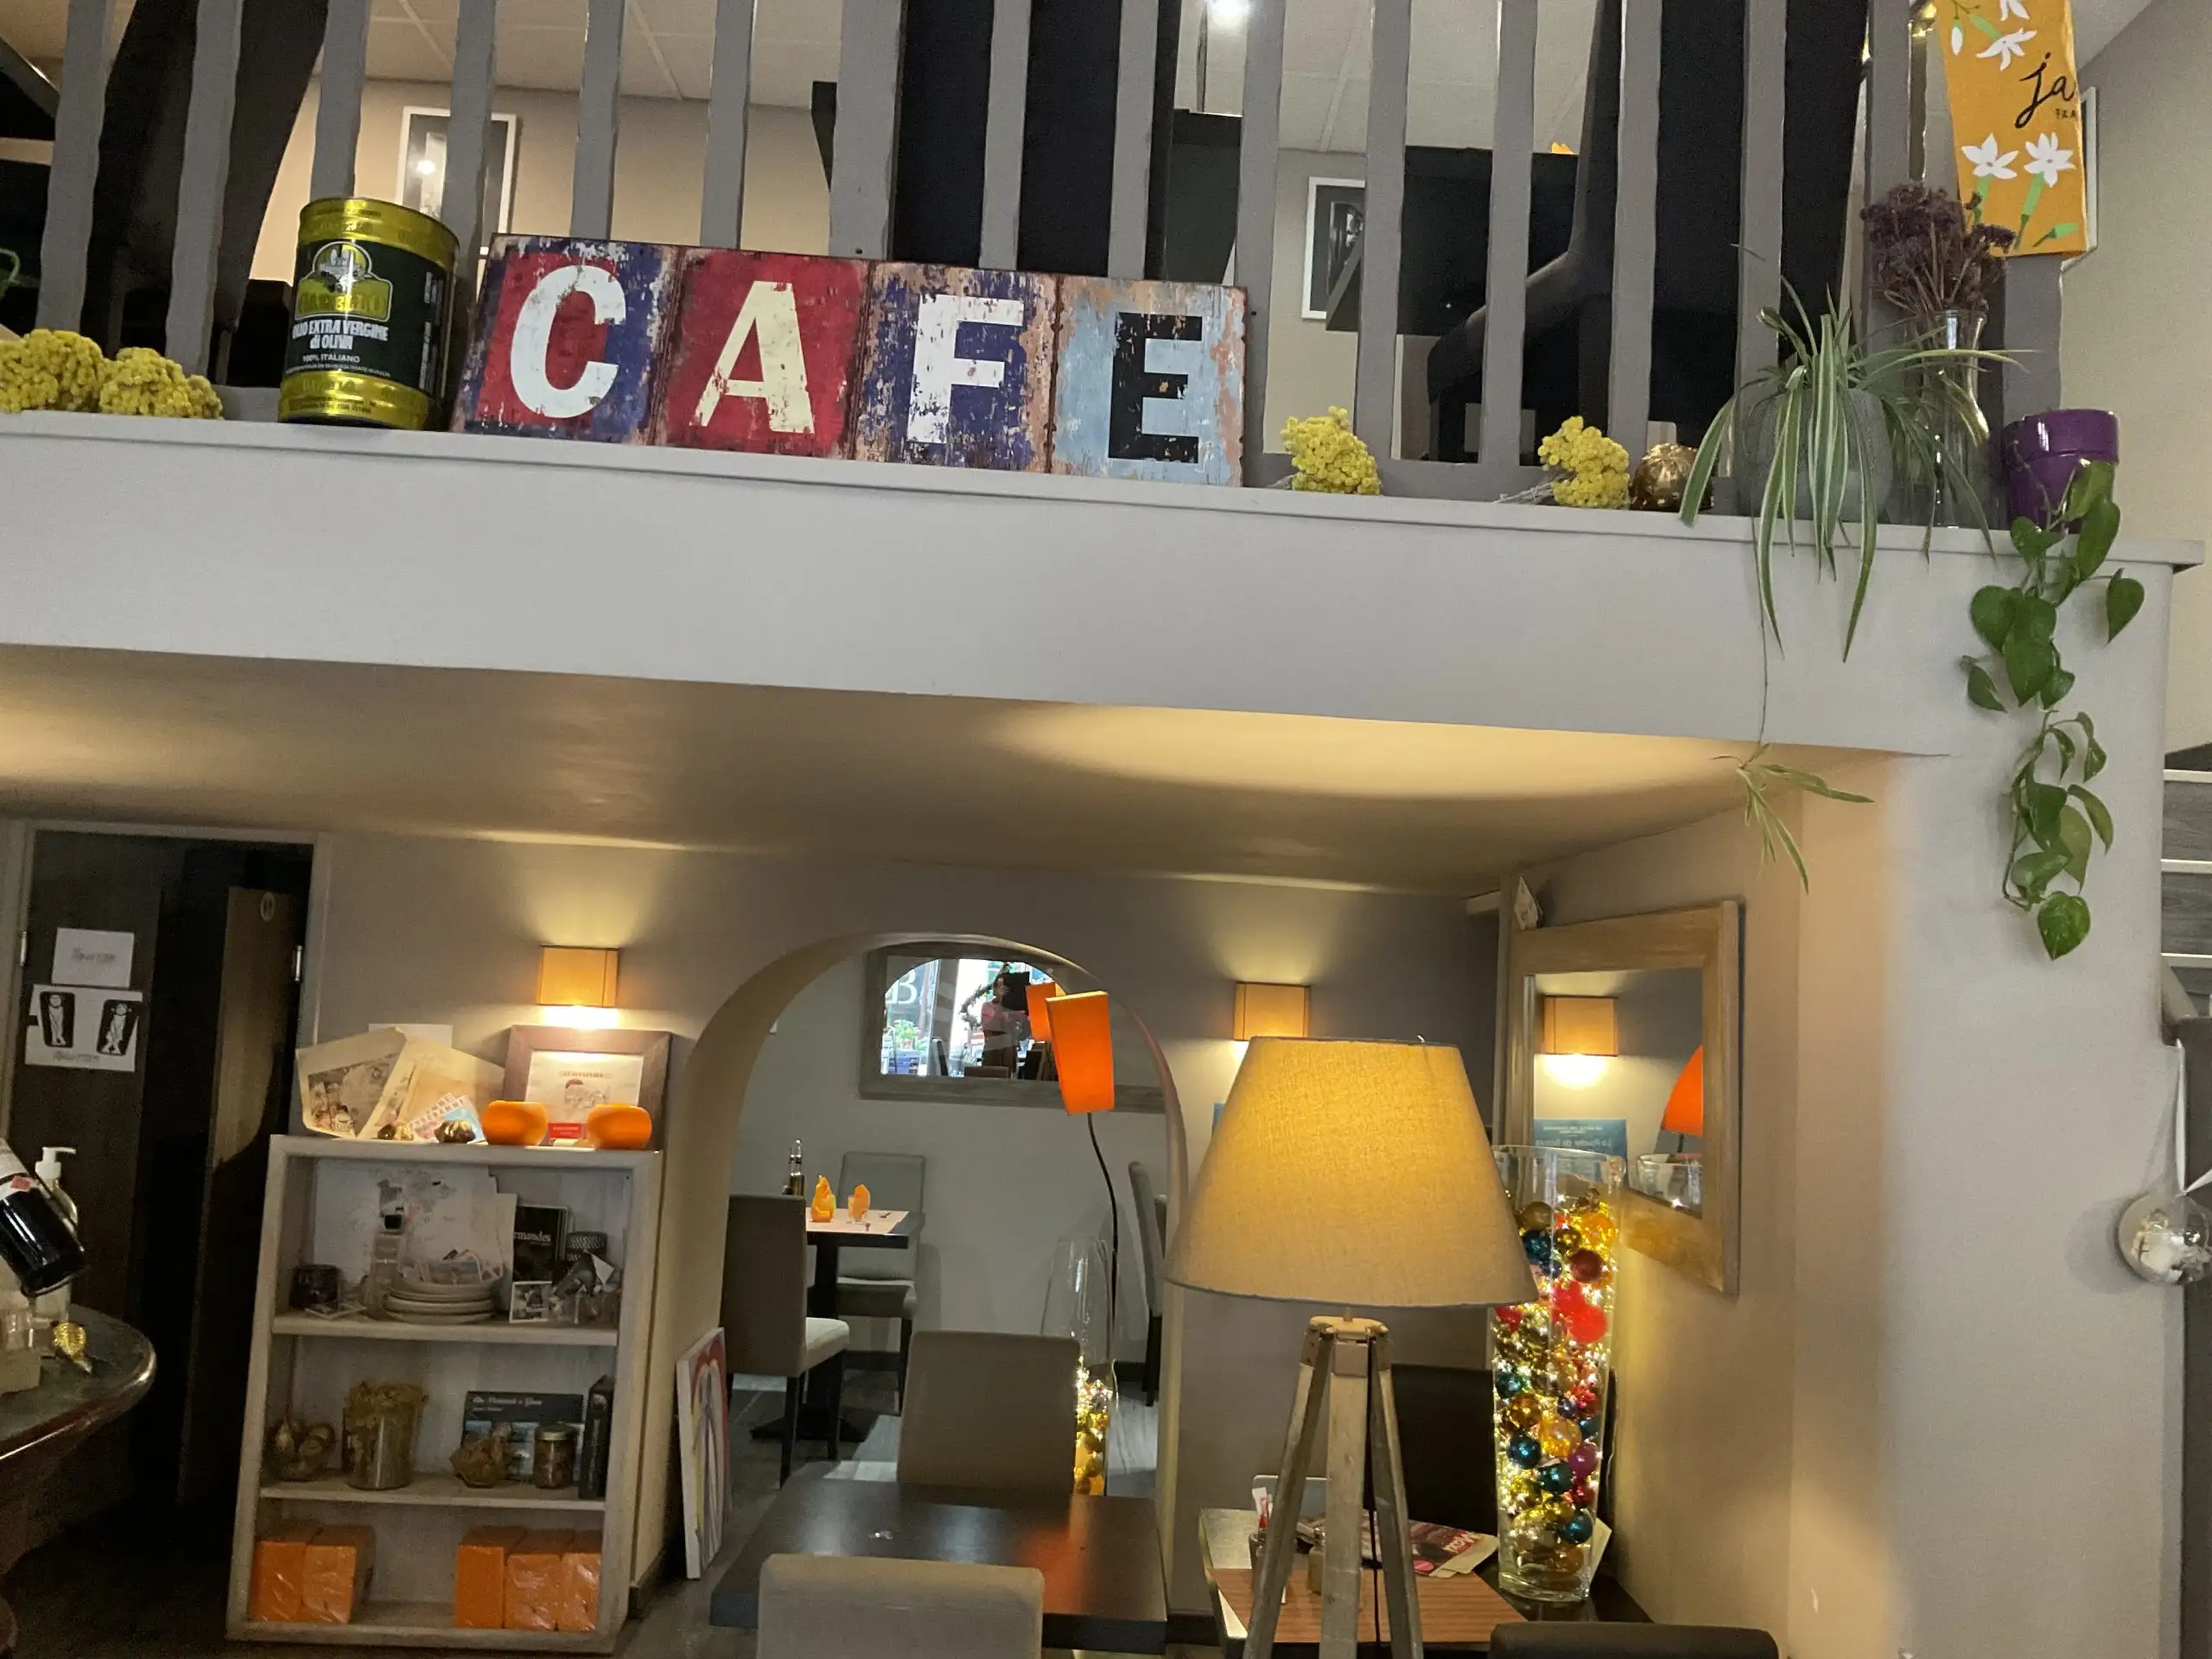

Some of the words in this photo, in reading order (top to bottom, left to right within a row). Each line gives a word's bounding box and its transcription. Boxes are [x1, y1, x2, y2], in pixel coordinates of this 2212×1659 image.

[308, 320, 341, 334] EXTRA
[343, 320, 389, 341] VERGINE
[321, 334, 353, 350] OLIVA
[321, 353, 360, 363] ITALIANO
[510, 264, 1205, 465] CAFE
